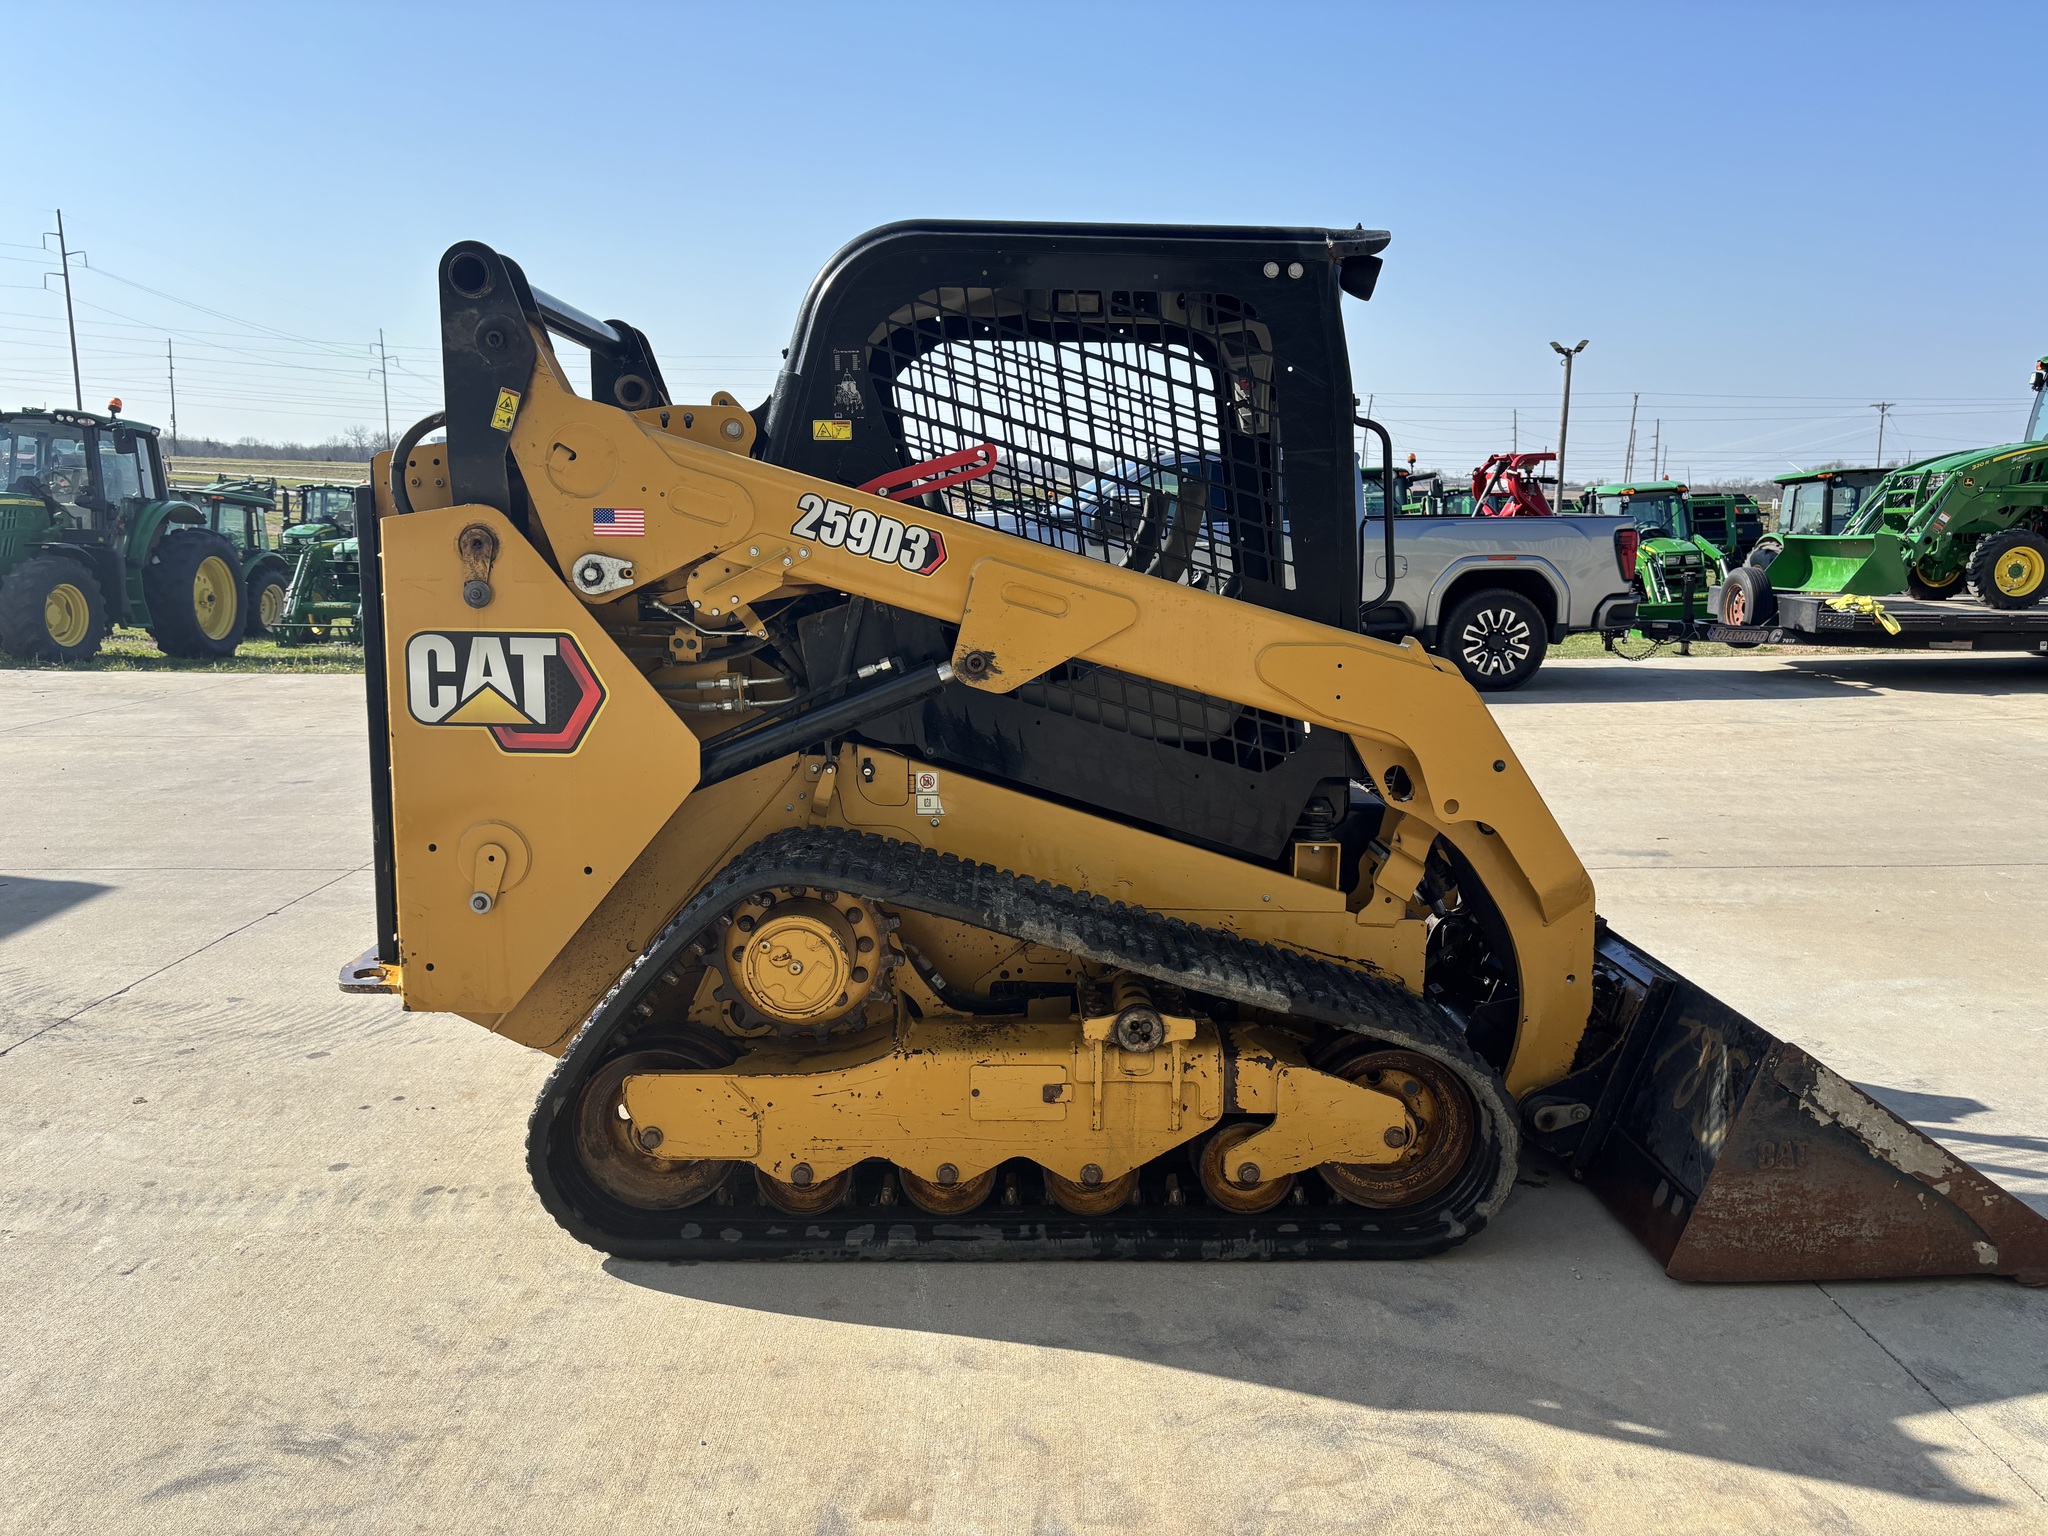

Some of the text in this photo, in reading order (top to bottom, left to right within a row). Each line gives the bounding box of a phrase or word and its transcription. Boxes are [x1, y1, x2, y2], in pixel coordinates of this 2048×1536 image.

[791, 493, 931, 571] 259D3
[1712, 627, 1768, 642] DIAMOND
[1769, 629, 1783, 643] C
[408, 633, 558, 725] CAT
[1757, 1140, 1809, 1170] CAT
